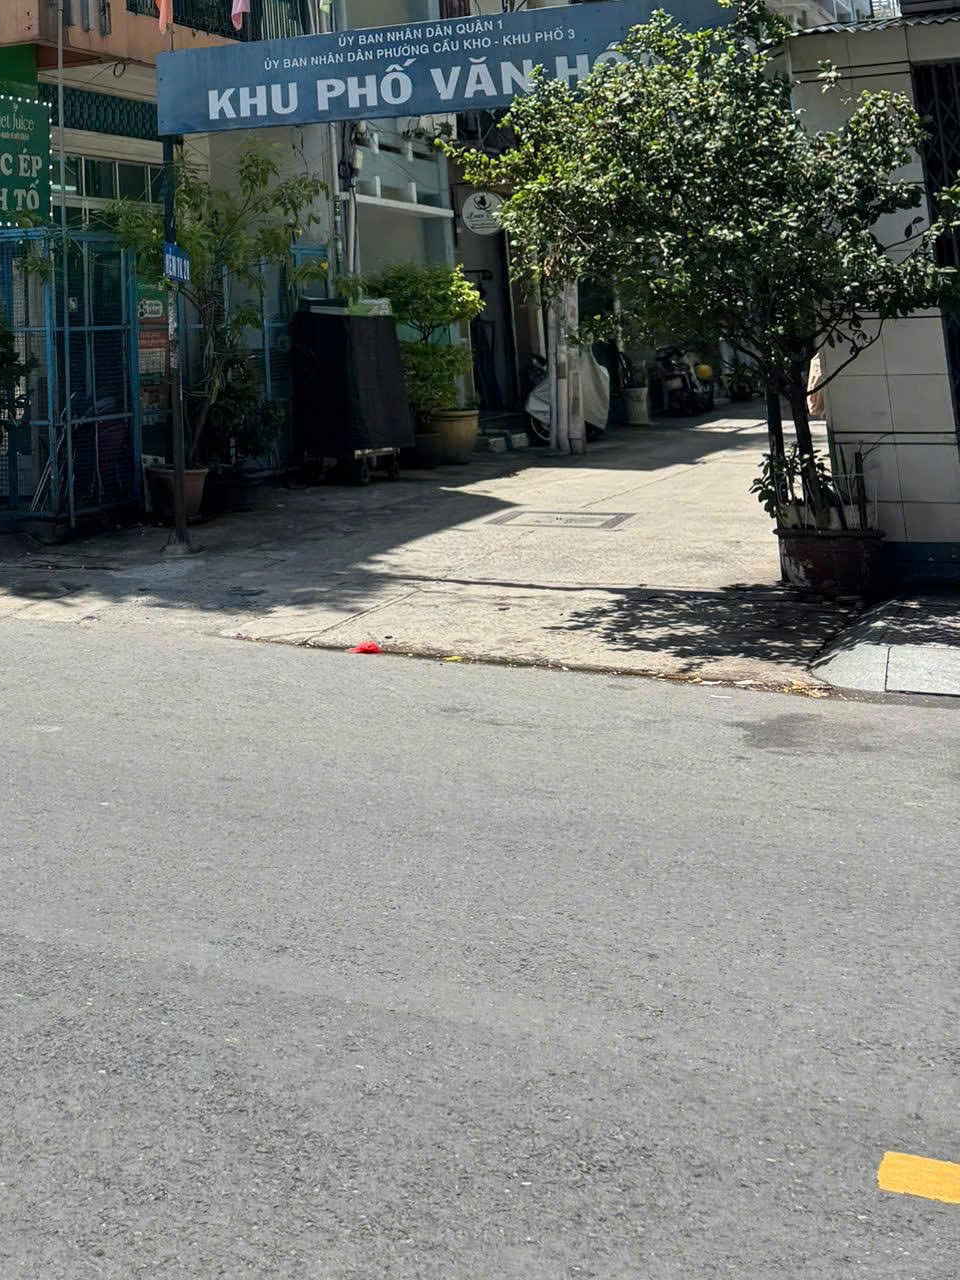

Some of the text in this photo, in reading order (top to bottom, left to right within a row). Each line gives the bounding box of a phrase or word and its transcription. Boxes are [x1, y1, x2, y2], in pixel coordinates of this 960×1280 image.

[283, 56, 307, 68] BAN
[310, 51, 344, 66] NHÂN
[347, 49, 373, 62] DÂN
[376, 43, 429, 60] PHƯỜNG
[463, 36, 491, 50] KHO
[502, 32, 531, 46] KHU
[535, 25, 564, 43] PHỐ
[567, 28, 576, 40] 3
[358, 32, 384, 45] BAN
[386, 27, 422, 42] NHÂN
[425, 24, 453, 38] DÂN
[456, 19, 493, 34] QUẬN
[497, 19, 503, 30] 1
[208, 81, 298, 120] KHU
[316, 58, 417, 111] PHỐ
[430, 56, 535, 101] VĂN
[18, 147, 43, 177] ÉP
[13, 179, 40, 212] TỐ
